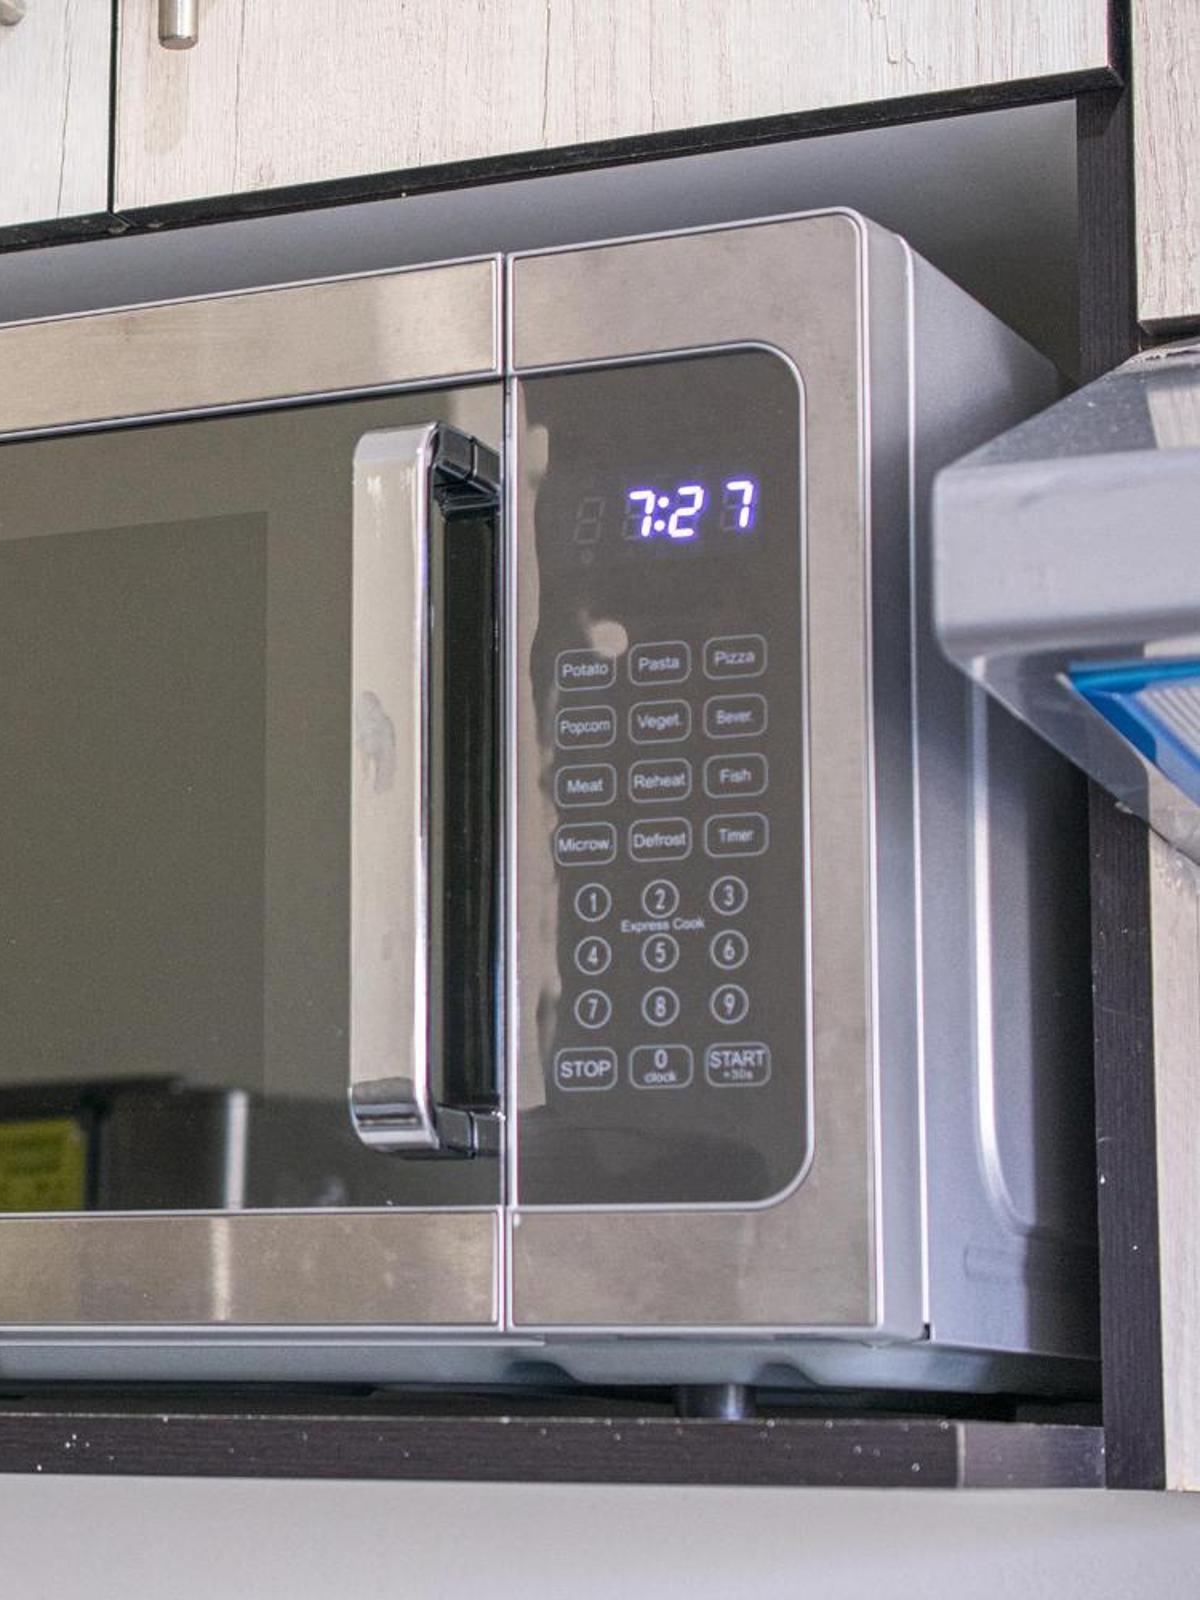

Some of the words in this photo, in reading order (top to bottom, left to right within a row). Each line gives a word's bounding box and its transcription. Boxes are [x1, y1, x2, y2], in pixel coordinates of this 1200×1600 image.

[638, 656, 680, 671] Pasta
[713, 650, 755, 665] Pizza
[562, 663, 609, 678] Potato
[633, 773, 686, 789] Reheat
[719, 768, 752, 782] Fish
[567, 778, 603, 793] Meat
[633, 832, 686, 848] Defrost
[718, 828, 754, 843] Timer
[655, 888, 666, 910] 2
[723, 884, 735, 906] 3
[620, 918, 670, 934] Express
[672, 916, 706, 931] Cook
[587, 945, 598, 966] 4
[655, 941, 666, 963] 5
[723, 938, 735, 961] 6
[587, 997, 599, 1020] 7
[654, 995, 666, 1018] 8
[723, 992, 736, 1016] 9
[654, 1048, 668, 1070] 0
[709, 1049, 766, 1069] START
[560, 1060, 612, 1079] STOP
[644, 1070, 677, 1084] clock
